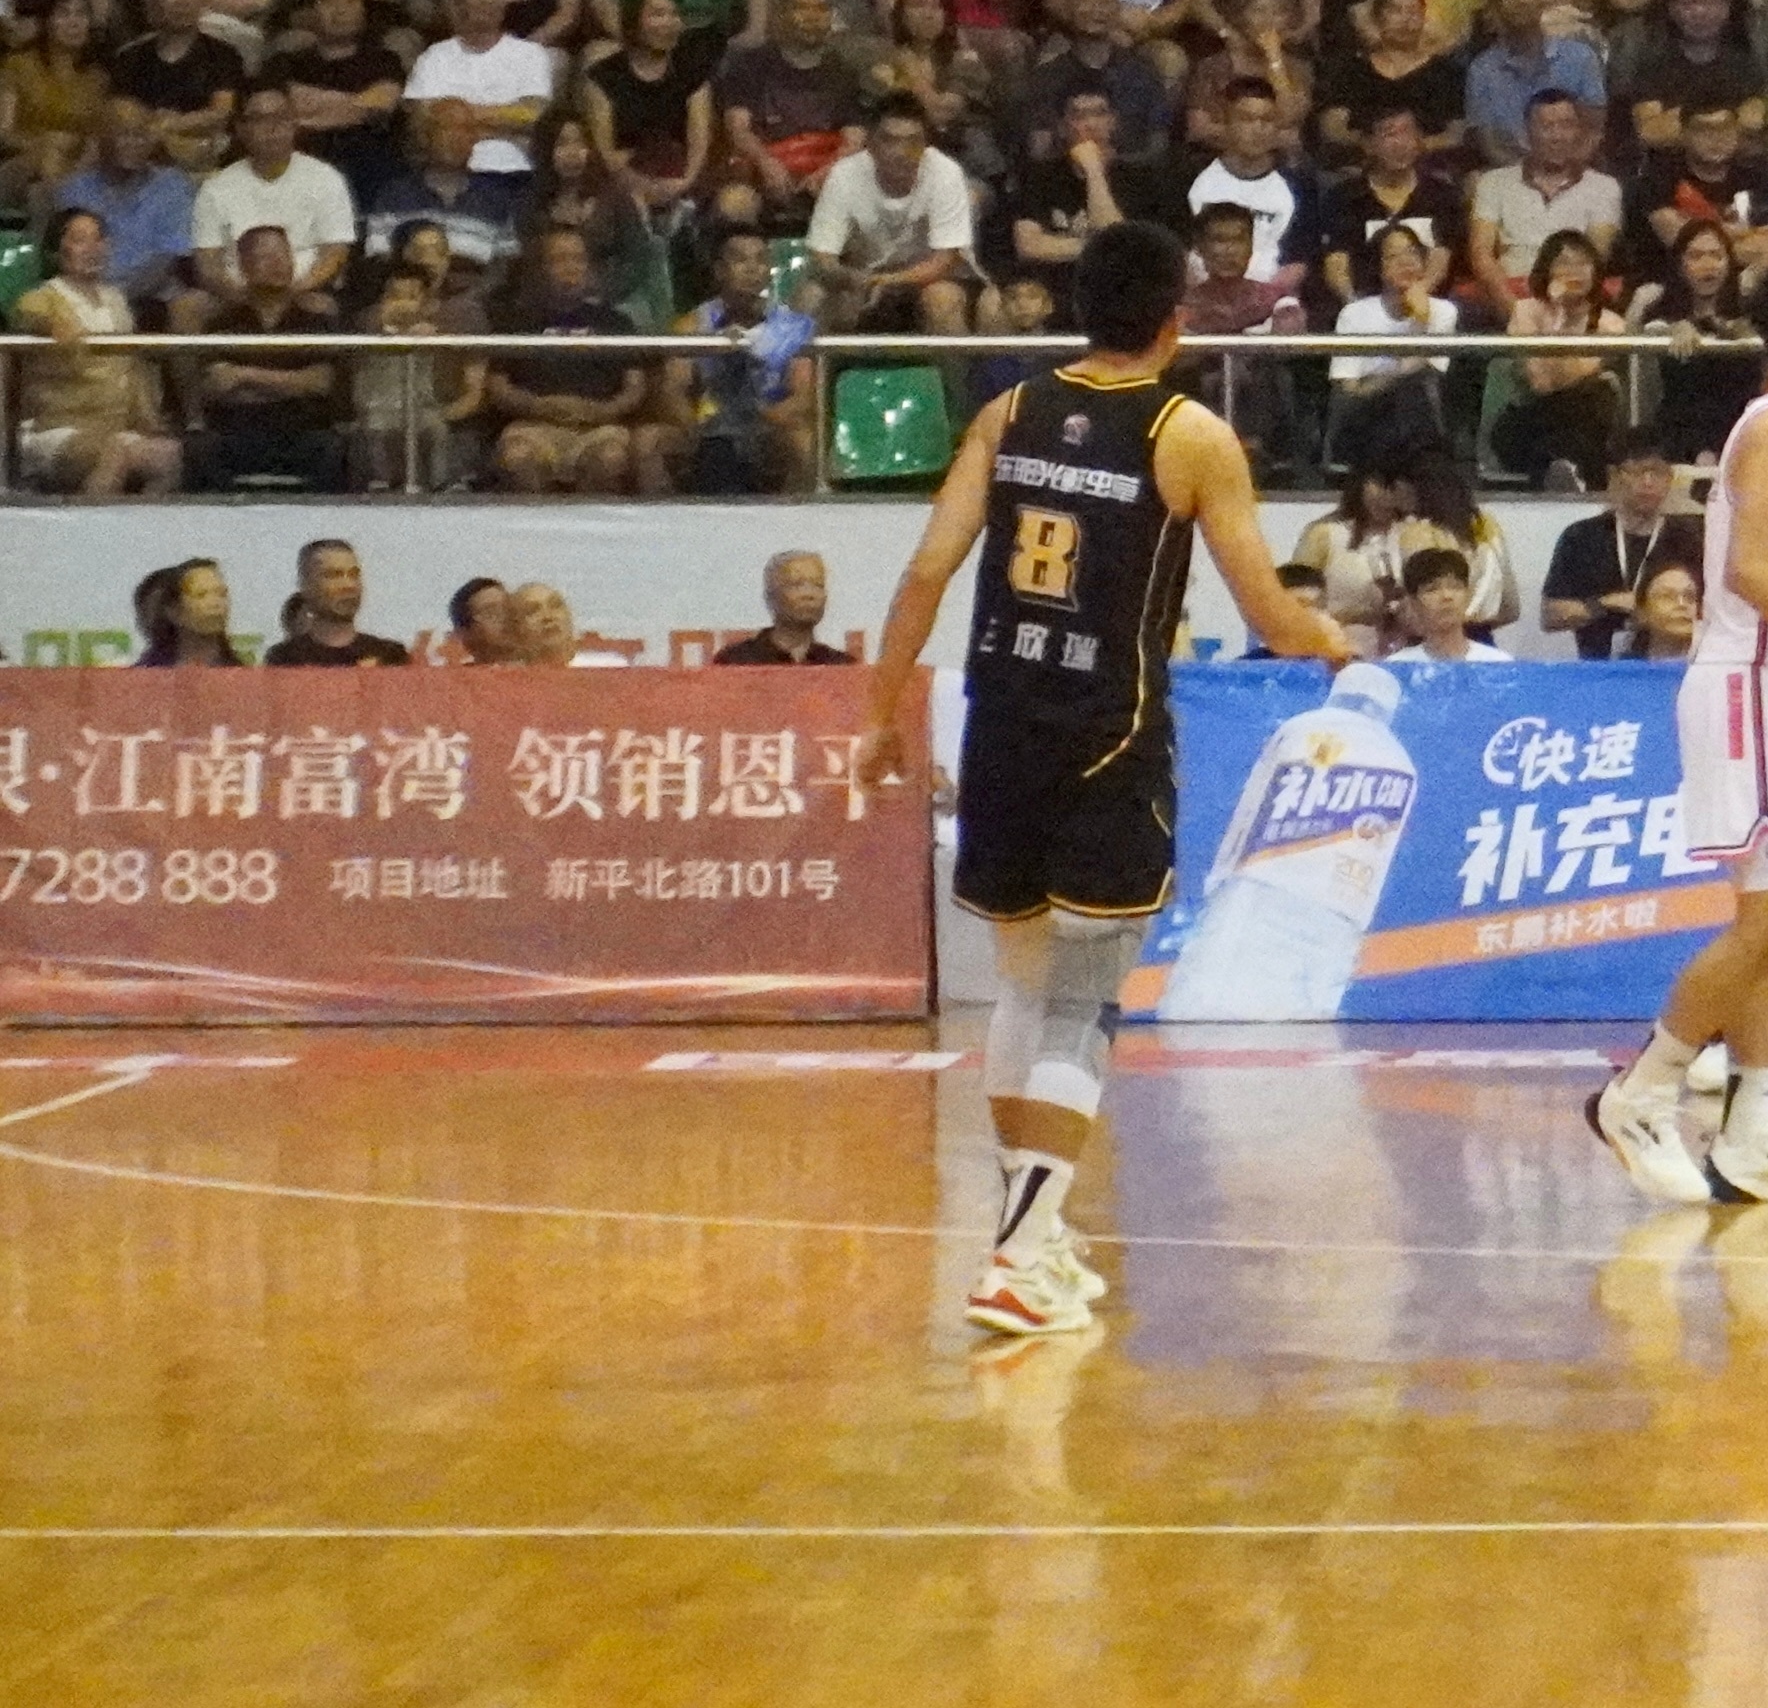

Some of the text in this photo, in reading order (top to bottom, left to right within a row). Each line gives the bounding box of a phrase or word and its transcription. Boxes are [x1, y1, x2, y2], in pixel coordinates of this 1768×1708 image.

[1009, 504, 1080, 612] 8
[1517, 720, 1642, 791] 快速
[329, 856, 841, 902] 项目地址 新平北路101号
